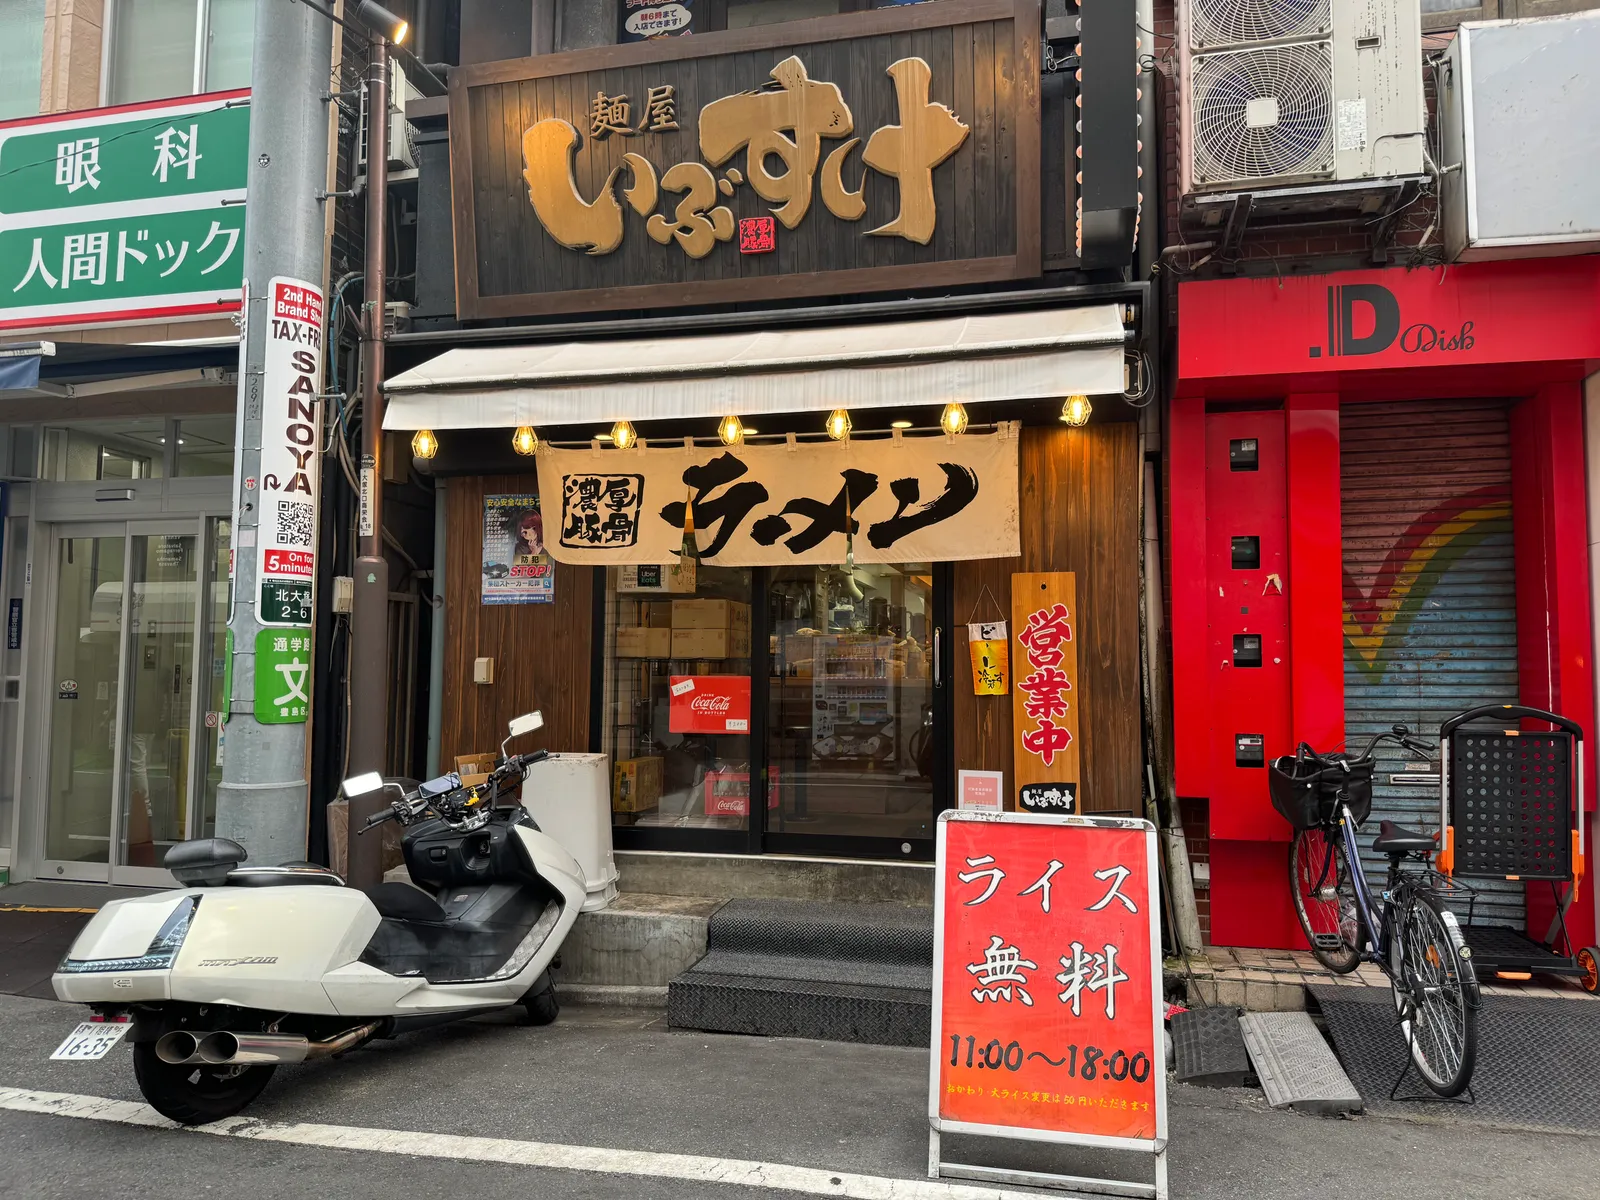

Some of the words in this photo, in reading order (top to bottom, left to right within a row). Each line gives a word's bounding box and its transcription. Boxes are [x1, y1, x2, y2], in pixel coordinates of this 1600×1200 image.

[55, 124, 202, 193] 眼科
[522, 55, 970, 258] いぶすけ
[13, 221, 240, 293] 人間ドック
[277, 301, 309, 318] Brand
[283, 288, 303, 303] 2nd
[1400, 321, 1475, 354] Dish
[284, 351, 316, 496] SANOYA
[658, 452, 979, 557] ラーメン
[268, 555, 280, 571] 5
[289, 553, 302, 562] On
[510, 564, 551, 577] STOP!
[521, 555, 540, 564] 防犯
[281, 605, 308, 619] 2-6
[1018, 603, 1072, 767] 営業中
[958, 854, 1138, 913] ライス
[966, 935, 1129, 1020] 無料
